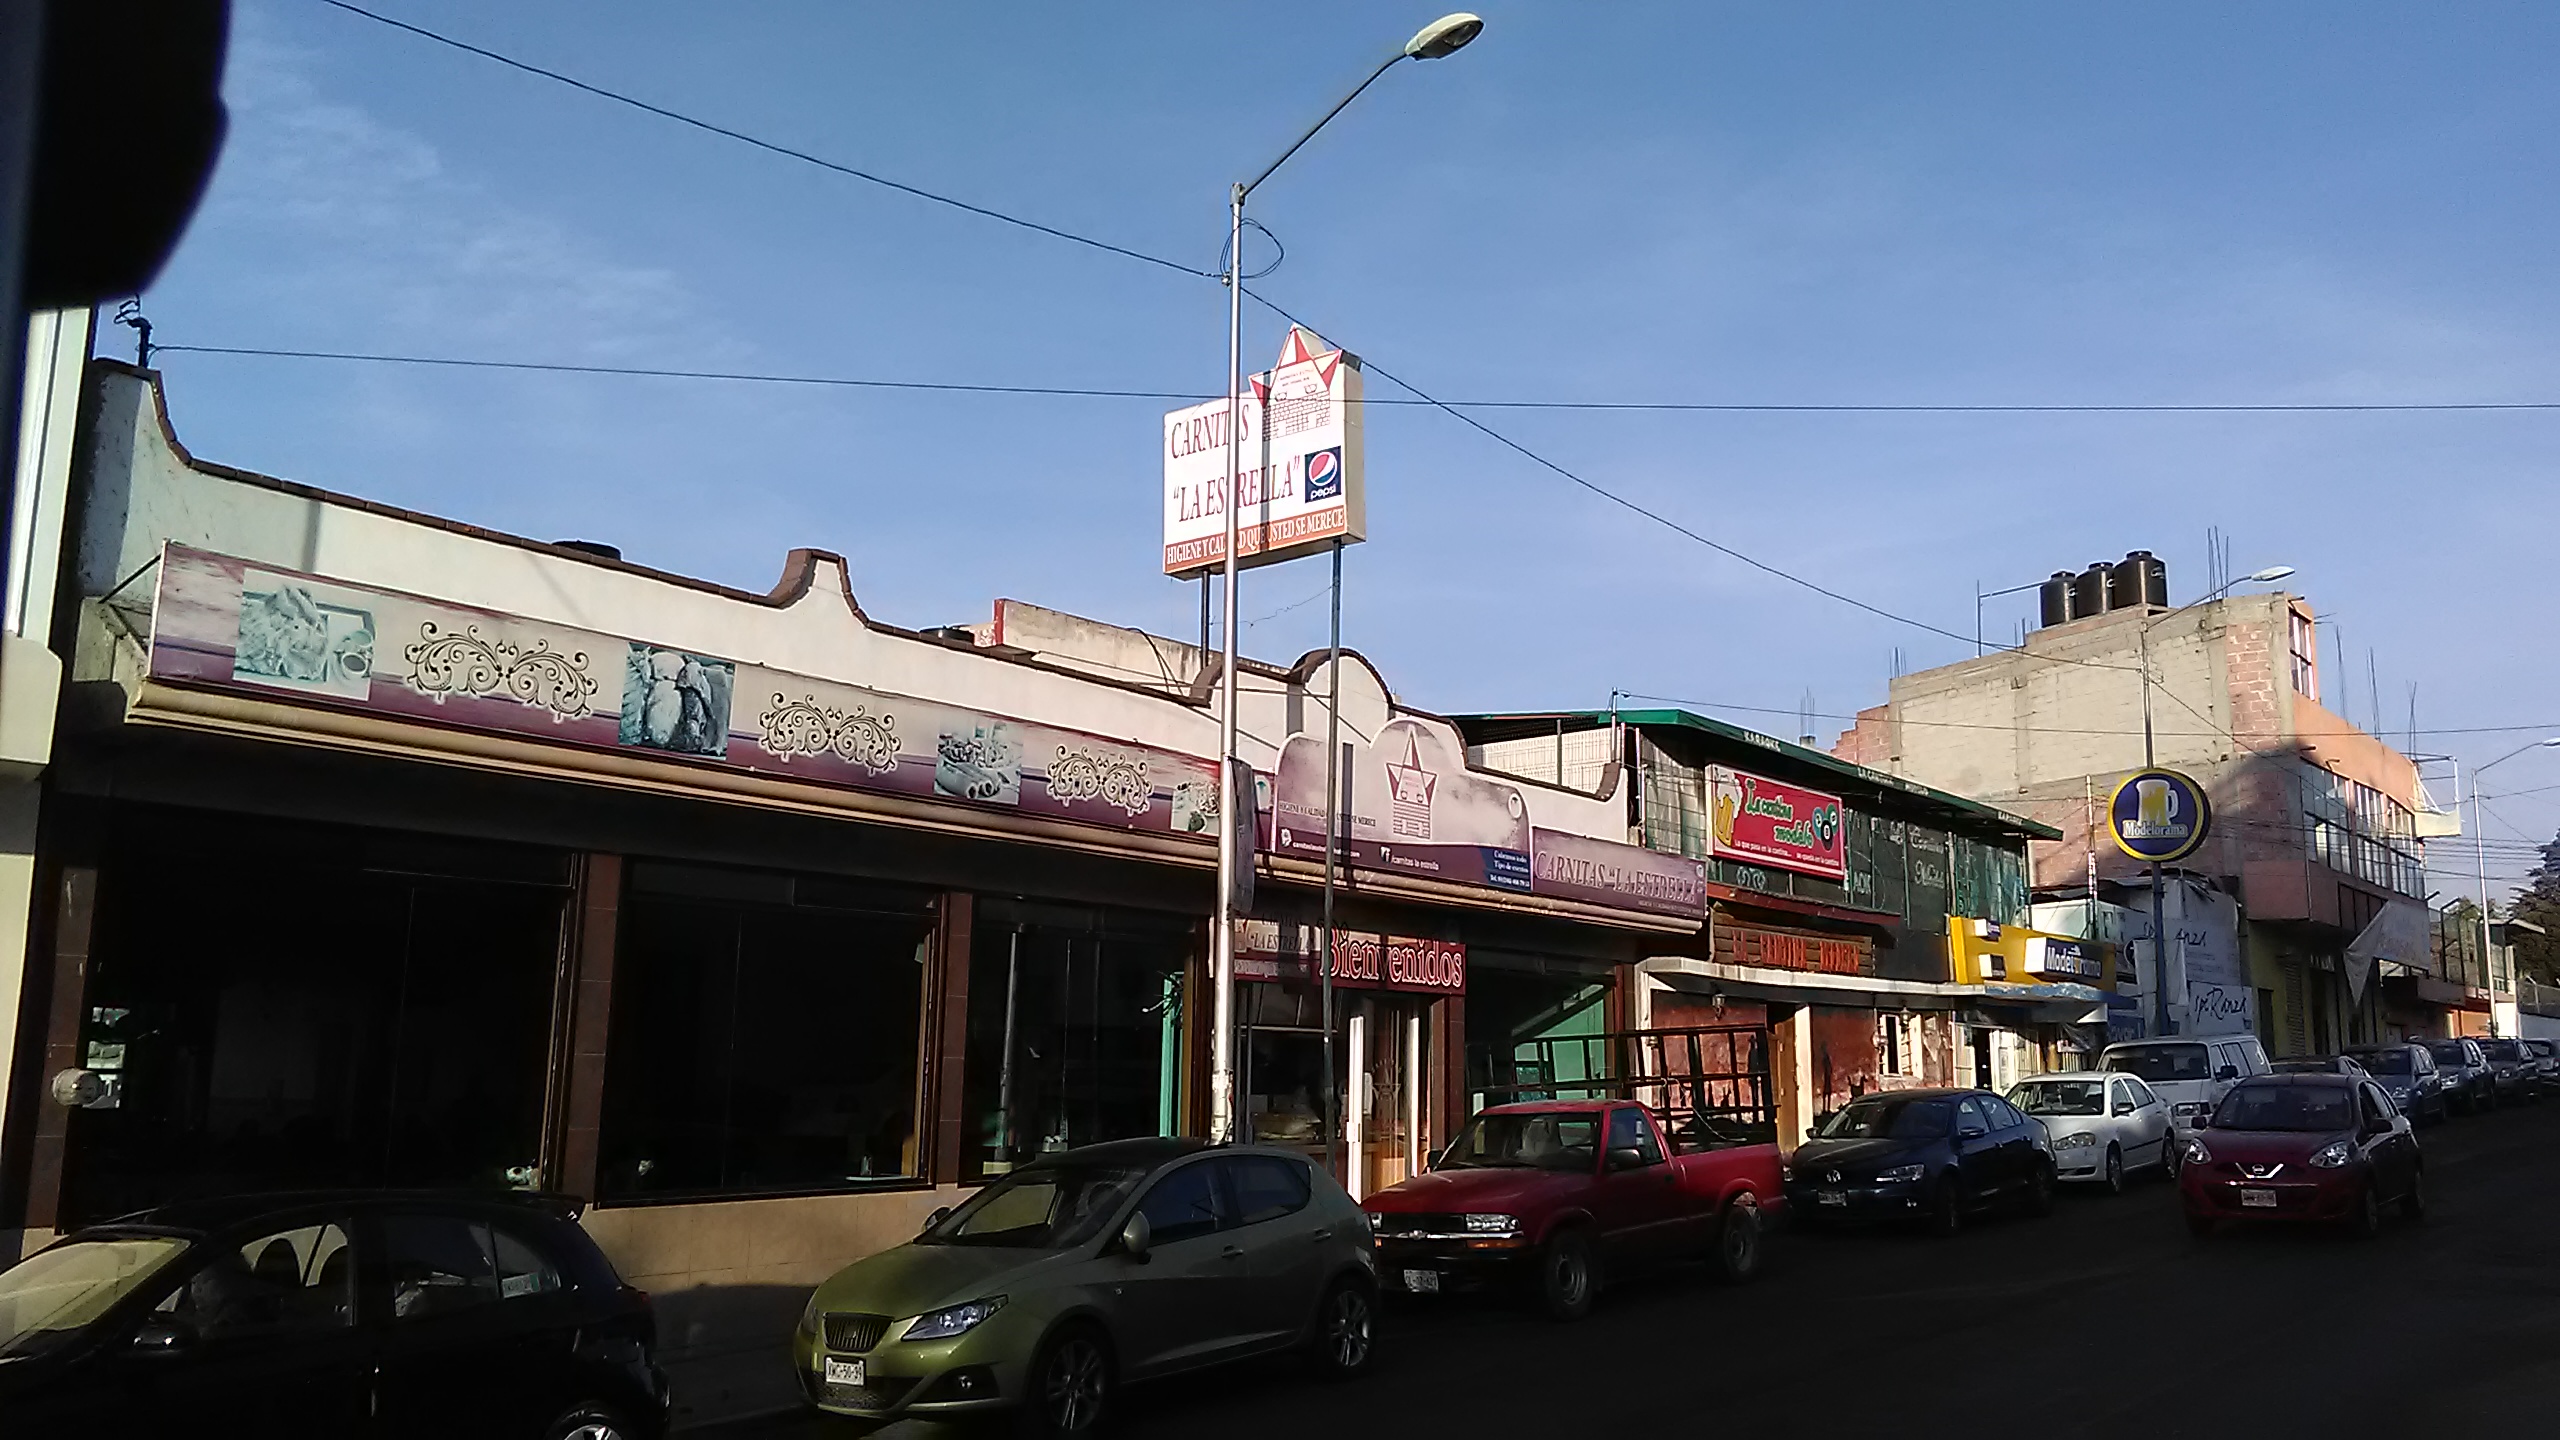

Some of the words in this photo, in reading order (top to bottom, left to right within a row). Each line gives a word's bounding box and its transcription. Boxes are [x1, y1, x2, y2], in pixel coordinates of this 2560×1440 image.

[1171, 403, 1249, 459] CARNITS
[1205, 454, 1300, 517] ESRELLA"
[1310, 483, 1337, 500] pepsi
[1166, 538, 1202, 565] HIGIENE
[1209, 529, 1247, 556] CALD
[1247, 526, 1266, 550] QUE
[1267, 520, 1294, 543] USTED
[1296, 517, 1307, 538] SE
[1307, 507, 1344, 534] MERECE
[2124, 821, 2187, 837] Modelorama
[1535, 850, 1606, 890] CARNITAS
[1319, 926, 1463, 987] Bienvenidos
